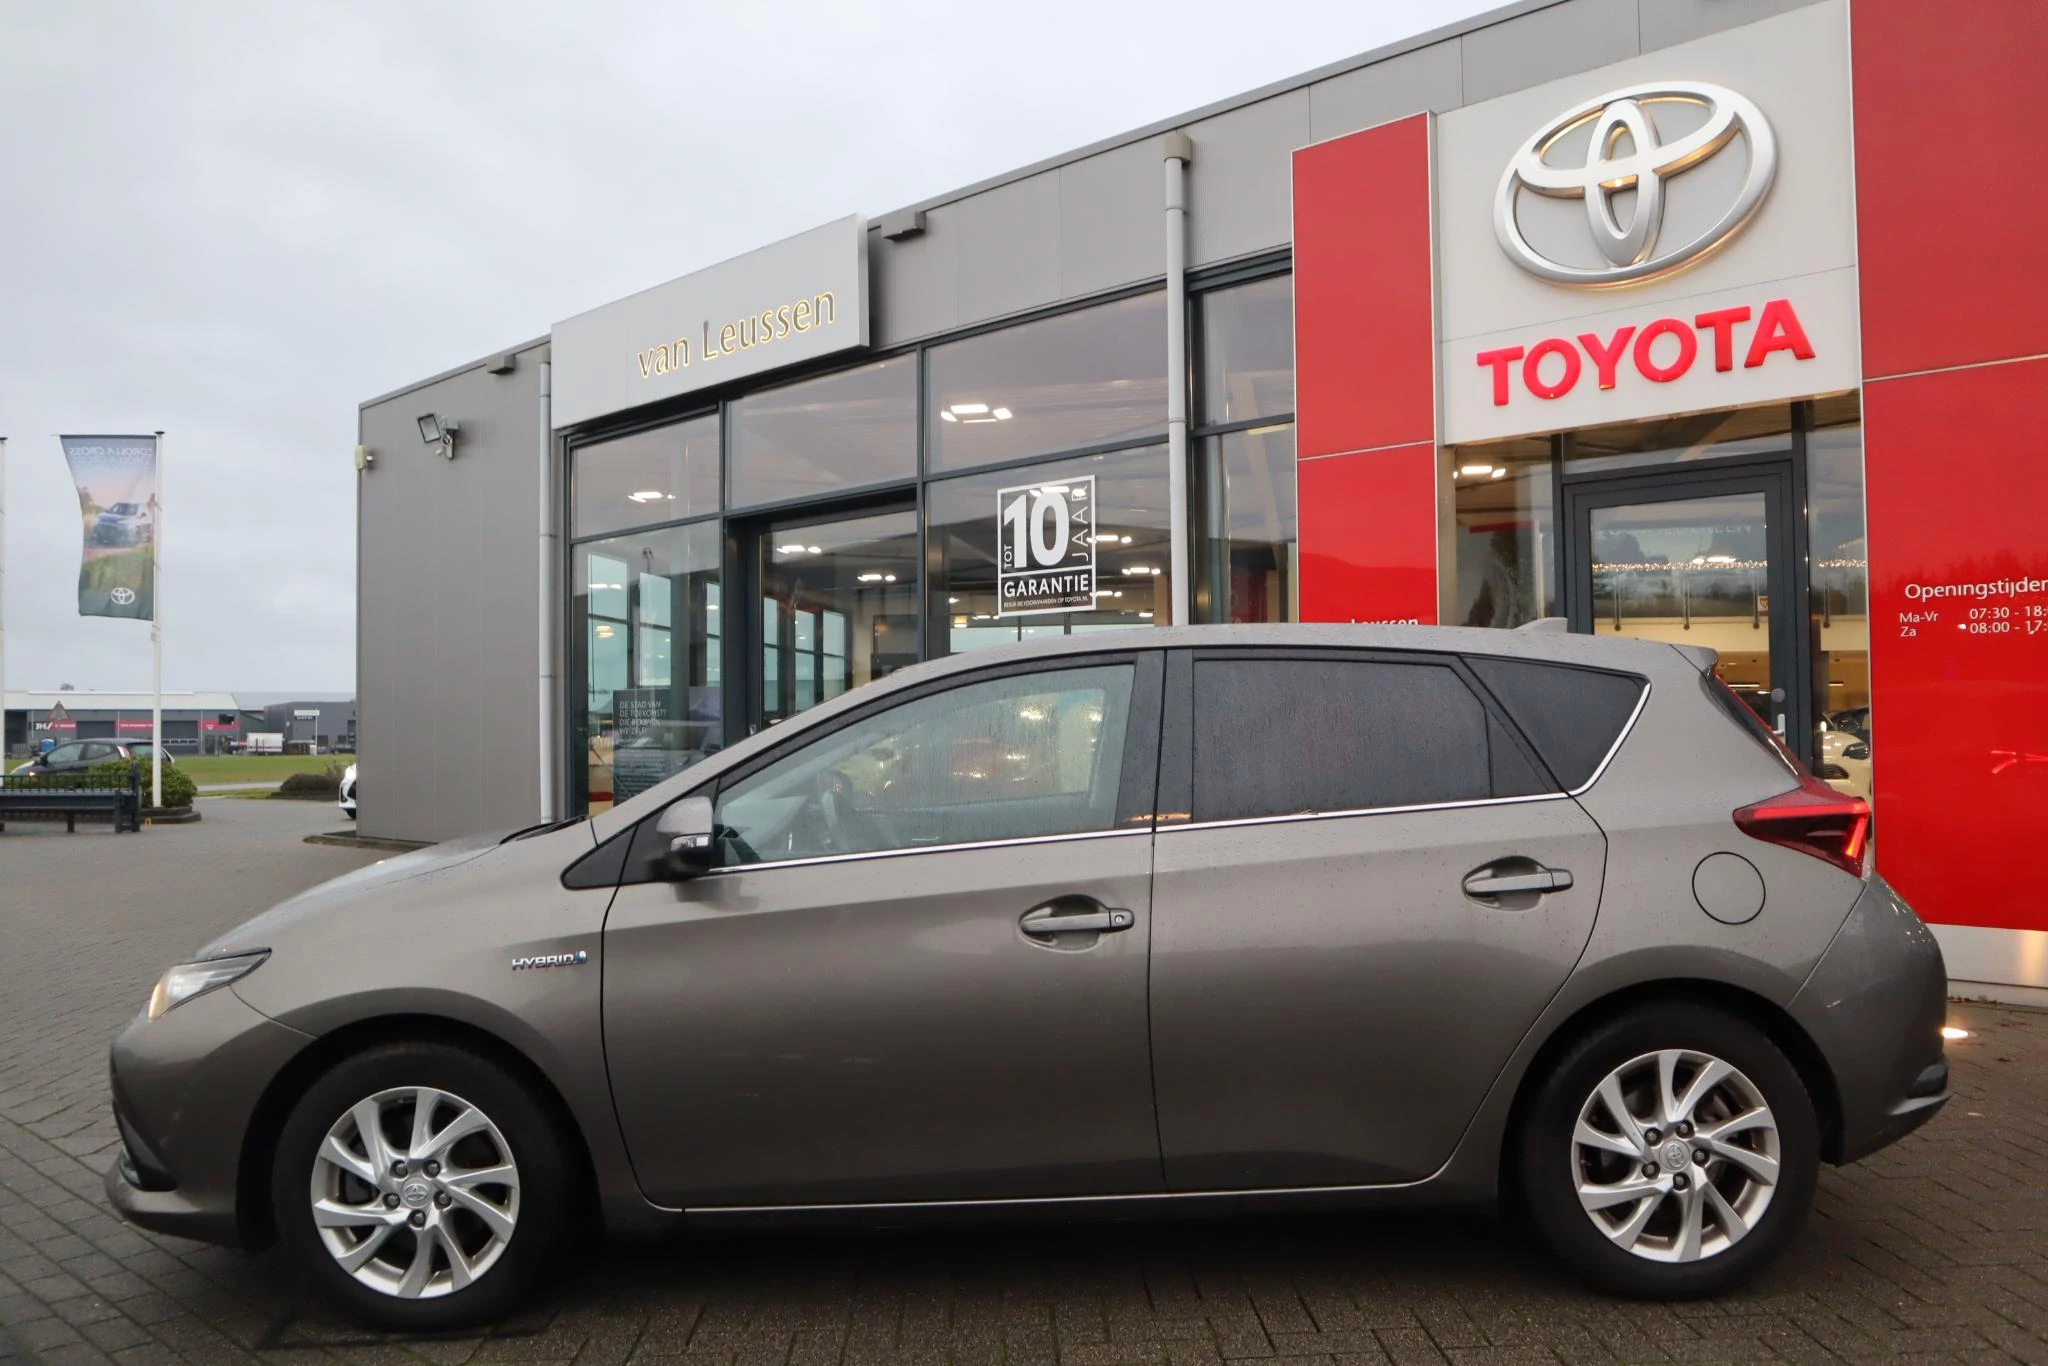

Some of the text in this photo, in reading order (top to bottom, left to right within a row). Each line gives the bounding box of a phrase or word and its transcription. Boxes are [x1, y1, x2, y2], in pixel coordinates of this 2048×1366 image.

[638, 291, 835, 379] van Leussen
[1477, 298, 1816, 407] TOYOTA
[1003, 491, 1070, 569] 10
[1071, 485, 1089, 561] JAAR
[1003, 544, 1013, 569] TOT
[1003, 574, 1089, 597] GARANTIE
[1899, 611, 1939, 623] Ma-Vr
[1969, 607, 2010, 620] 07:30
[2024, 605, 2048, 617] 18:
[1900, 626, 1917, 637] Za
[1970, 621, 2010, 634] 08:00
[2025, 620, 2048, 633] 17:
[619, 710, 629, 718] DE
[512, 954, 574, 968] HYBRID
